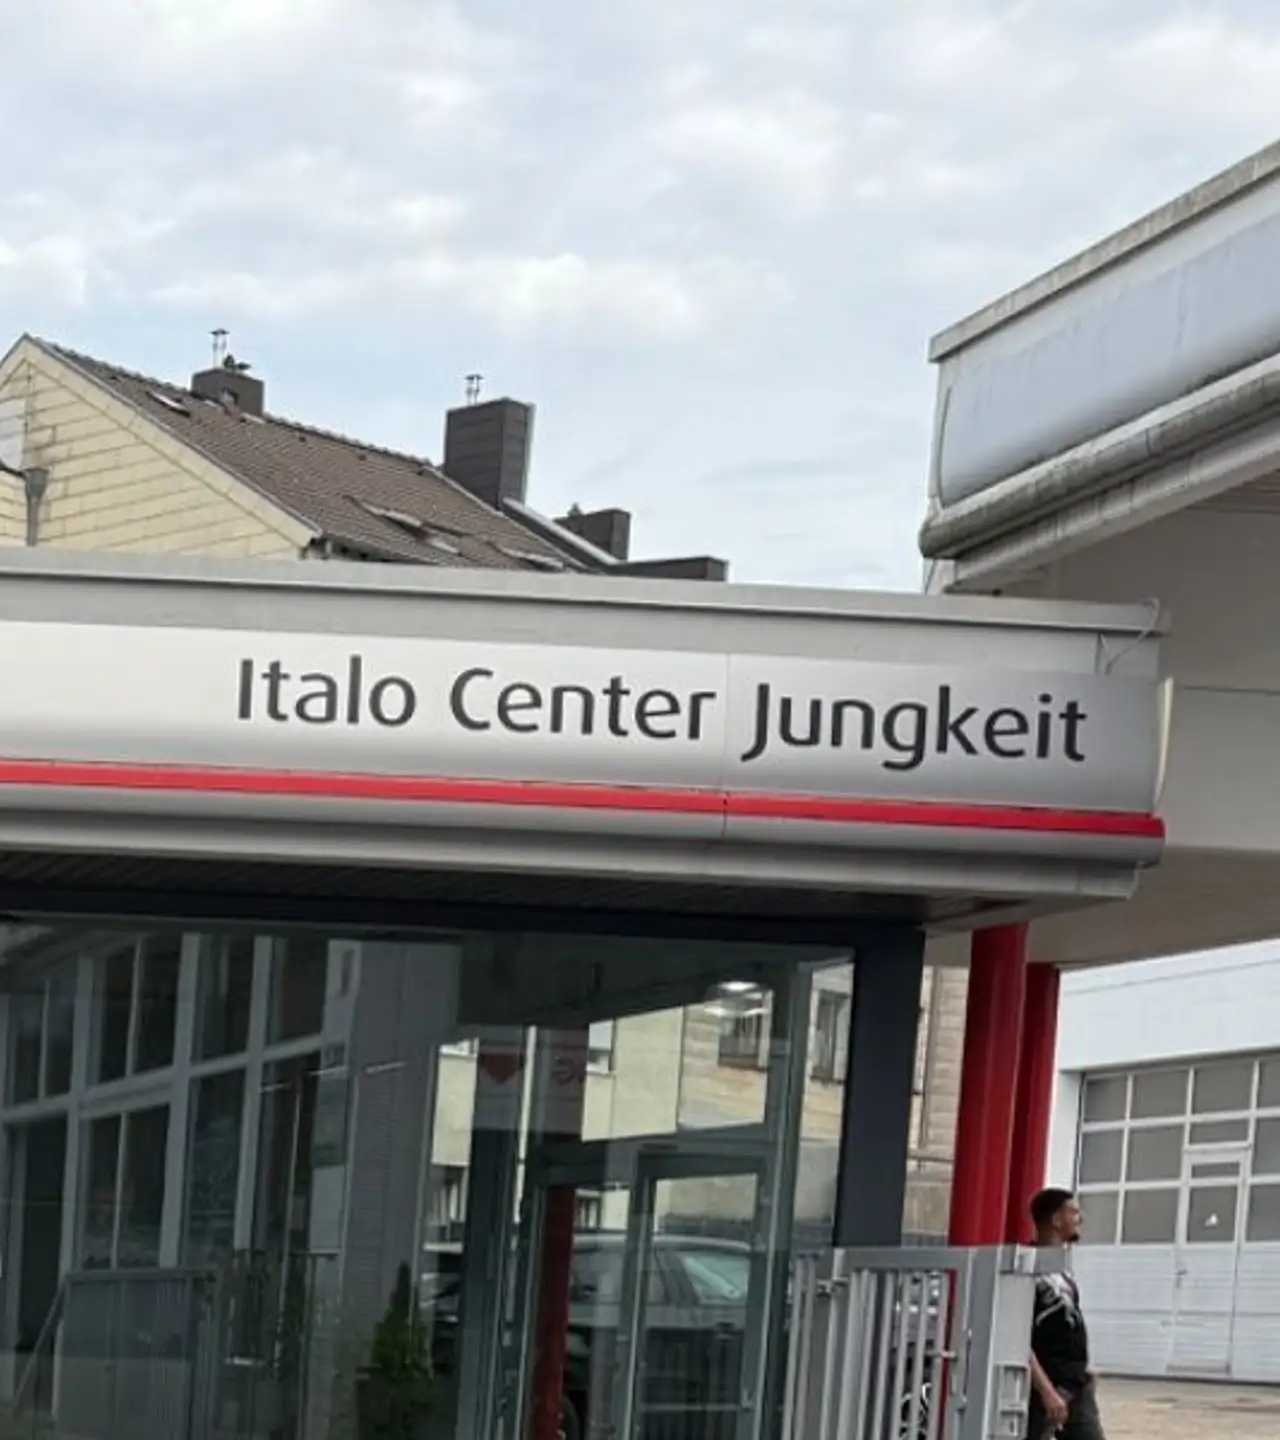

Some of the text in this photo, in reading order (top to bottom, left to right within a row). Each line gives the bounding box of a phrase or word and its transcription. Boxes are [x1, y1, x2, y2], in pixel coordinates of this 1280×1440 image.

[237, 653, 1088, 771] Italo Center Jungkeit
